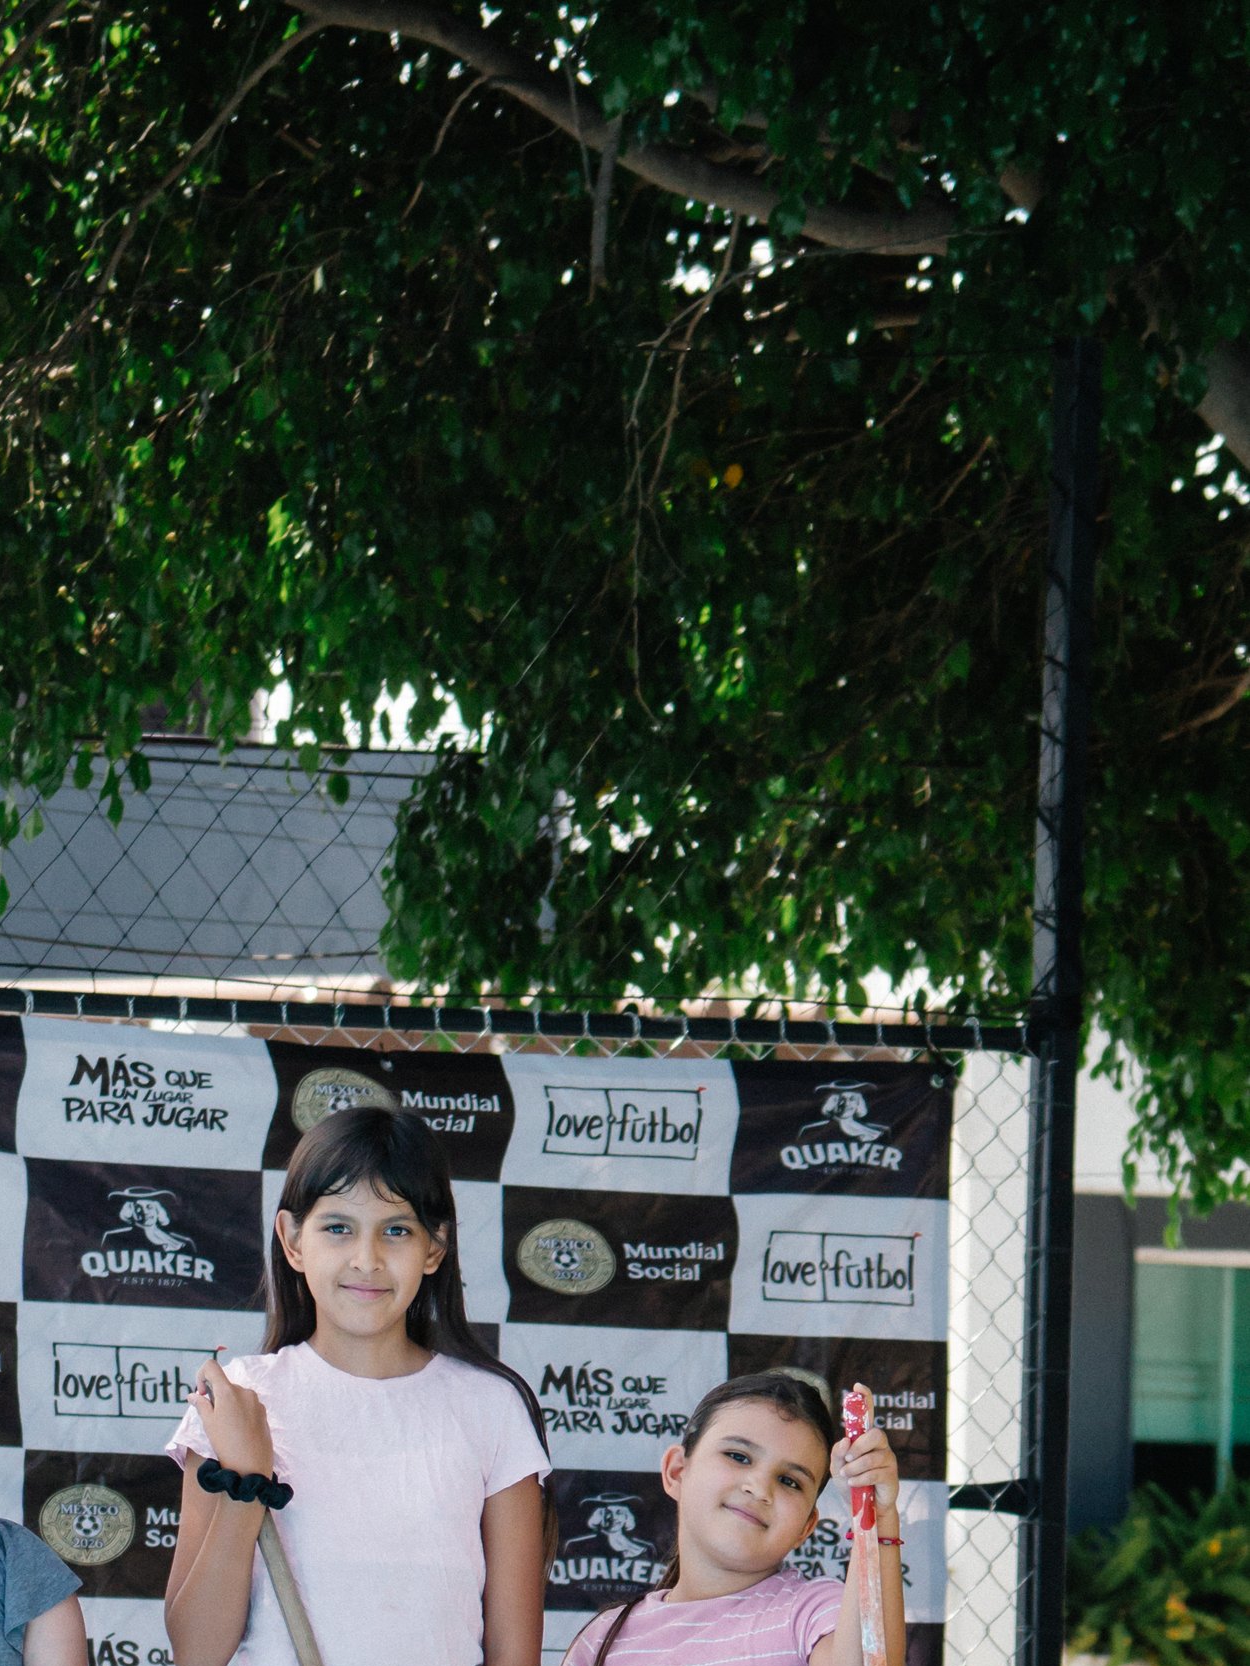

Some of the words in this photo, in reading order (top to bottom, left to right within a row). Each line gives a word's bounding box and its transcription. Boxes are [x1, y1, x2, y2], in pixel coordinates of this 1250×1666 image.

[69, 1053, 156, 1097] MÁS
[165, 1070, 214, 1090] QUE
[112, 1088, 138, 1100] UN
[142, 1089, 194, 1104] LUGAR
[401, 1090, 500, 1113] Mundial
[62, 1097, 136, 1125] PARA
[142, 1103, 228, 1132] JUGAR
[422, 1114, 475, 1133] cial
[547, 1100, 603, 1140] love
[780, 1142, 903, 1171] QUAKER
[623, 1243, 724, 1261] Mundial
[80, 1250, 215, 1282] QUAKER
[627, 1263, 700, 1281] Social
[762, 1247, 817, 1287] love
[54, 1359, 113, 1400] love
[539, 1360, 615, 1406] MÁS
[621, 1375, 668, 1395] QUE
[578, 1396, 602, 1408] UN
[606, 1397, 653, 1411] LUGAR
[871, 1391, 937, 1409] ndial
[541, 1408, 605, 1434] PARA
[611, 1411, 690, 1439] JUGAR
[874, 1412, 914, 1430] cial
[72, 1537, 104, 1549] 2026
